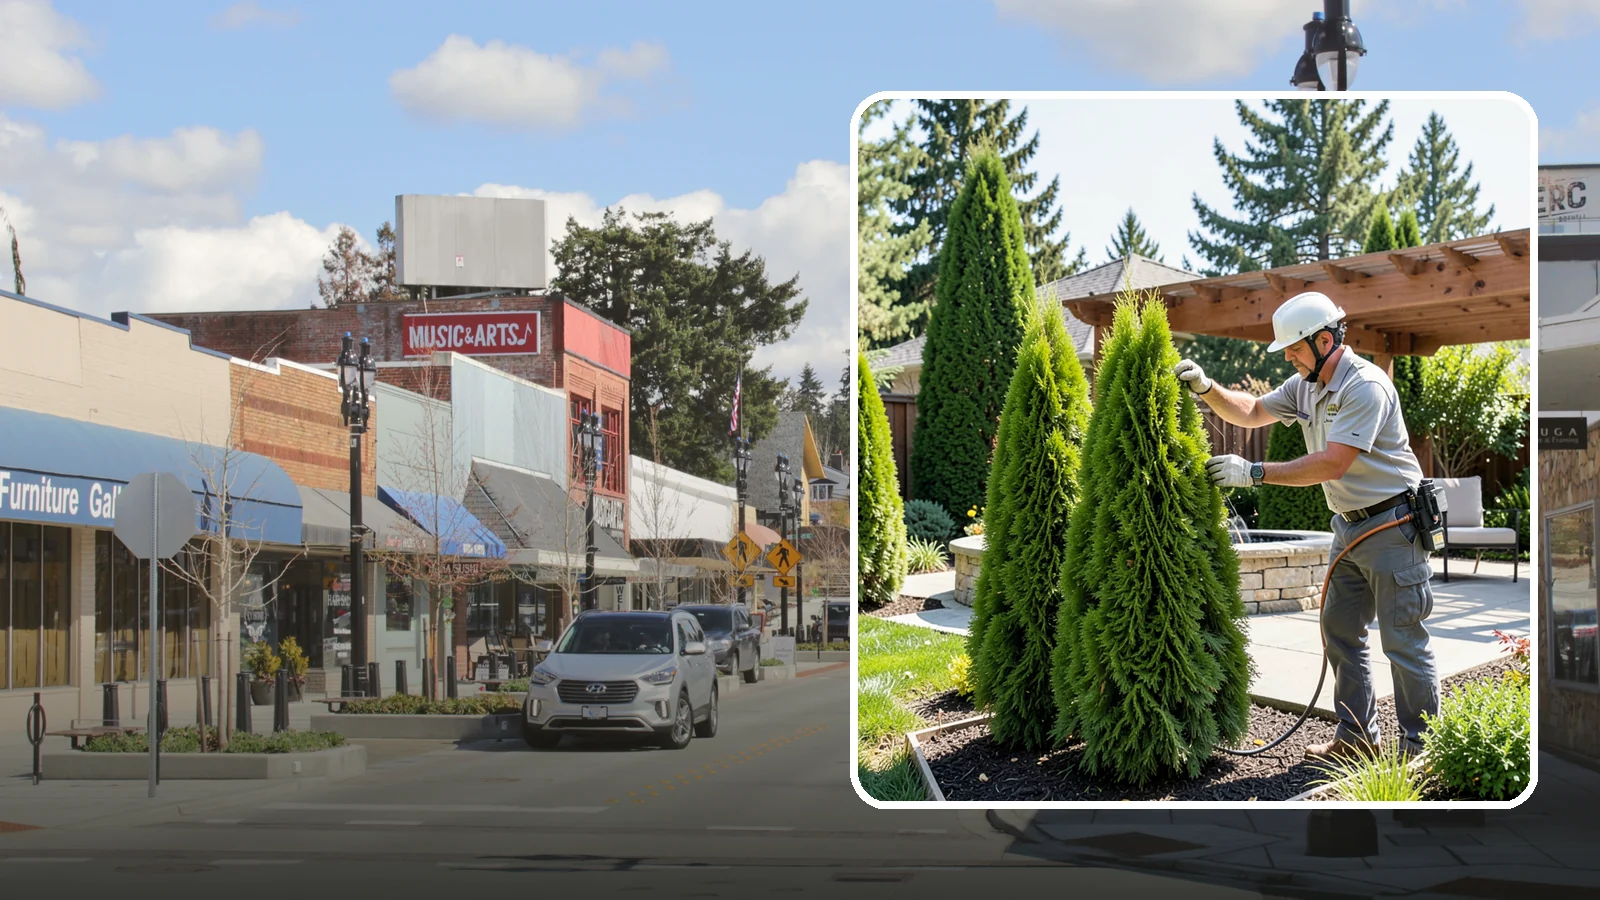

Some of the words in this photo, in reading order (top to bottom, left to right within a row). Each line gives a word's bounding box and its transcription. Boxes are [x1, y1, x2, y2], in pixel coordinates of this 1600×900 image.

[409, 323, 520, 348] MUSIC&ARTS
[1540, 427, 1577, 437] UGA
[0, 471, 79, 514] Furniture
[453, 563, 479, 574] SUSHI
